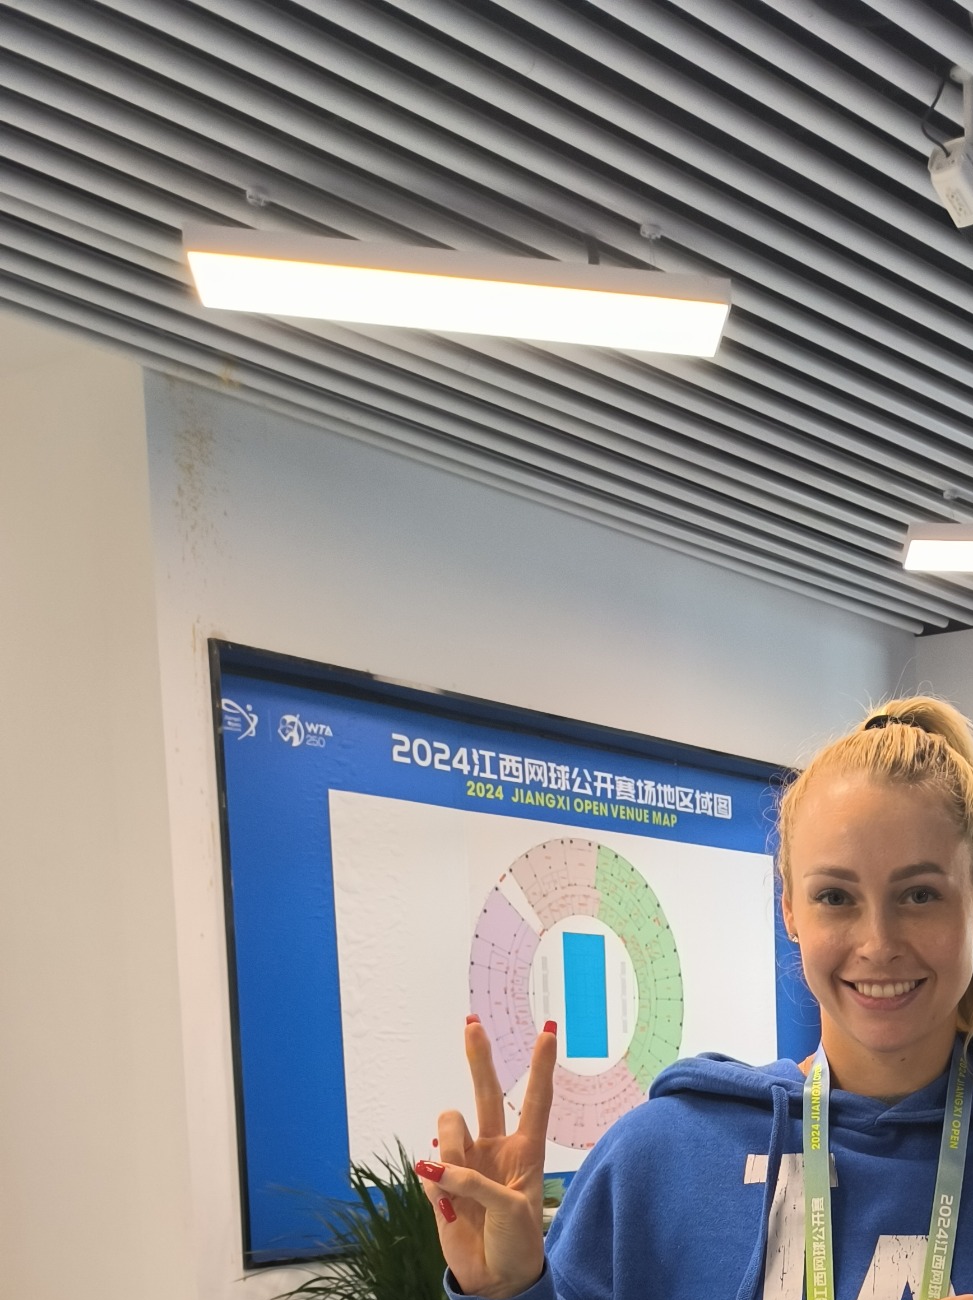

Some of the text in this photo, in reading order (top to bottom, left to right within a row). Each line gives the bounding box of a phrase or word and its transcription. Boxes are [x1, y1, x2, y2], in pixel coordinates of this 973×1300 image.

[305, 721, 333, 737] WTA
[391, 733, 733, 819] 2024江西网球公开赛场地区域图
[466, 780, 678, 828] 2024 JIANGXI OPEN VENUE MAP
[811, 1081, 822, 1121] JIANGXI
[953, 1080, 965, 1117] JIANGXI
[811, 1123, 820, 1150] 2024
[949, 1120, 961, 1149] OPEN
[927, 1194, 954, 1300] 2024江西网球
